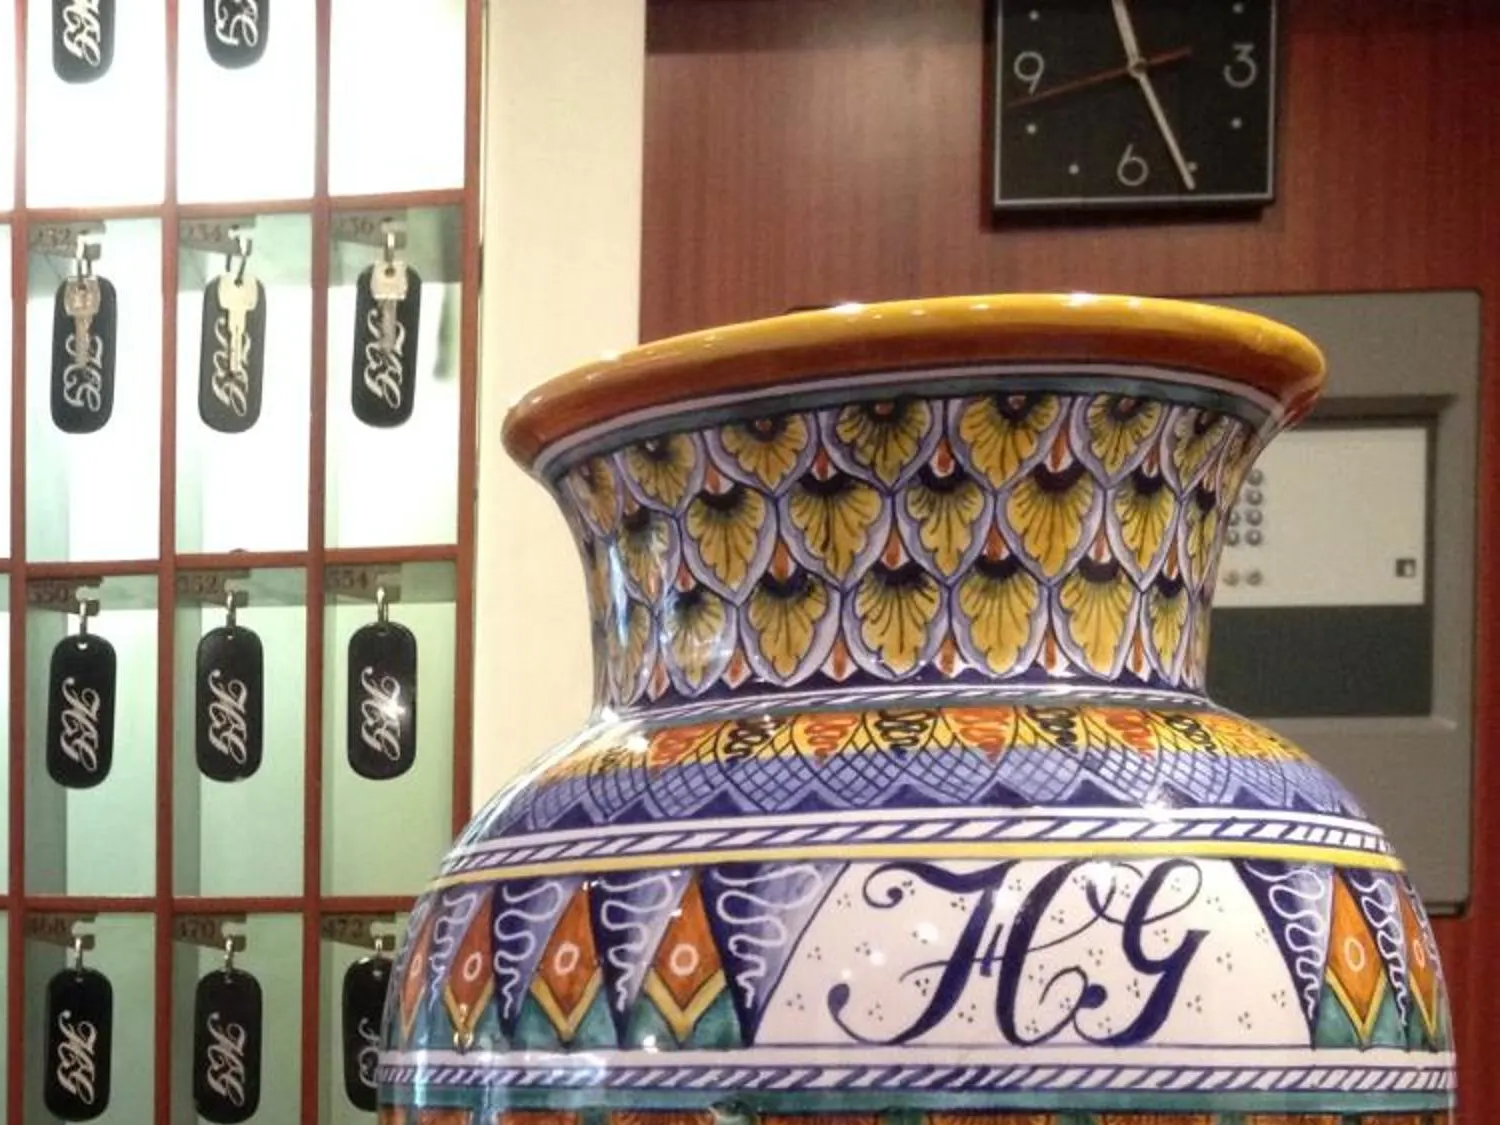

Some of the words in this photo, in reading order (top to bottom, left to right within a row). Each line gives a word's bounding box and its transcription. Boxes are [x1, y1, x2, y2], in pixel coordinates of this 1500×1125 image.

[1013, 50, 1045, 95] 9
[1223, 43, 1258, 89] 3
[1116, 143, 1149, 187] 6
[826, 858, 1210, 1048] HG
